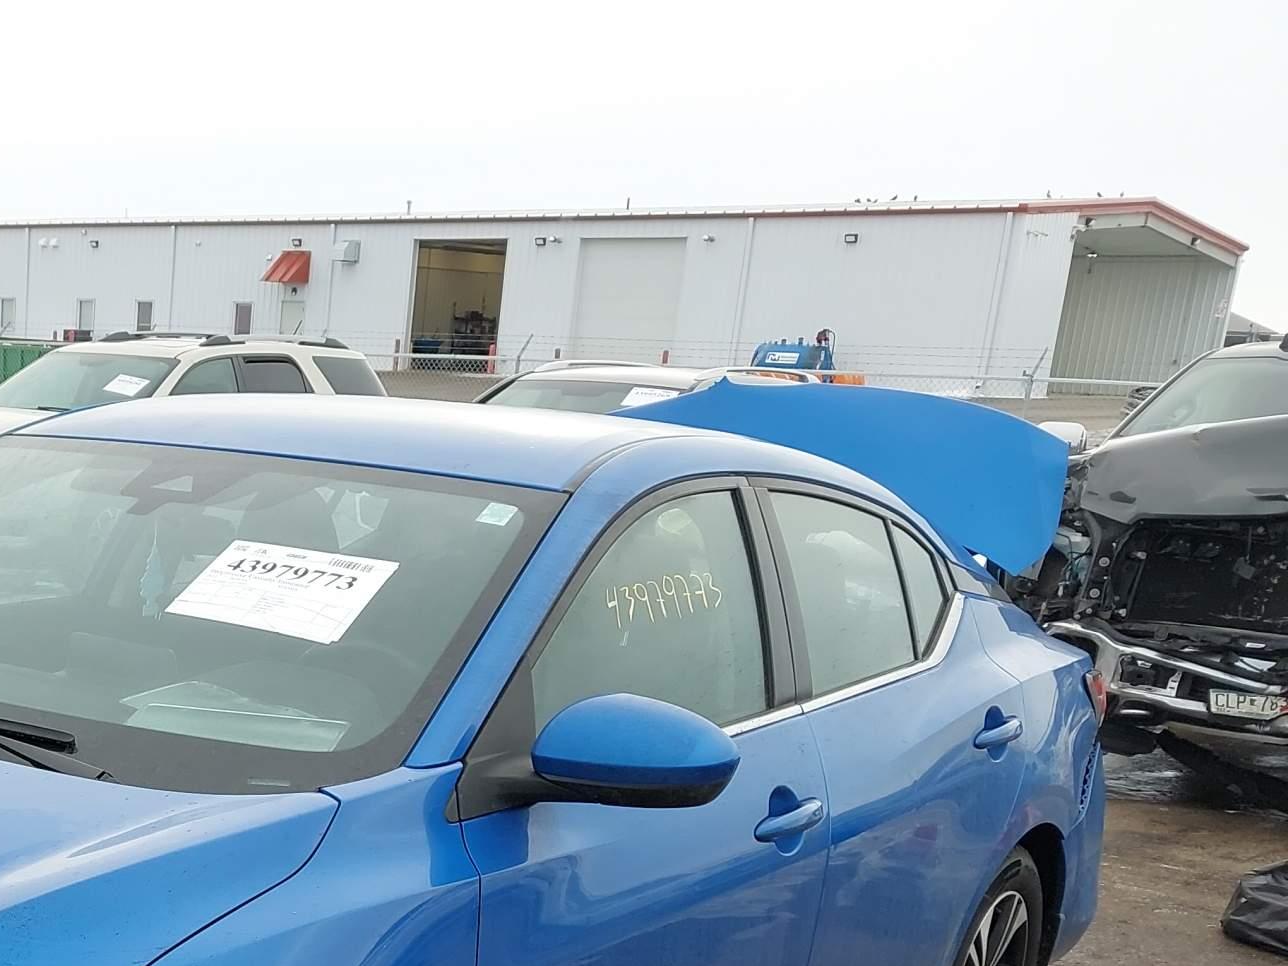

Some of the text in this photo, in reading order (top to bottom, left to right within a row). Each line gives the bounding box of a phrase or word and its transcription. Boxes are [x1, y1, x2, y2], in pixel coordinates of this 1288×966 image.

[226, 558, 358, 591] 43979773
[606, 572, 722, 629] 43979773
[1215, 693, 1247, 710] CLP
